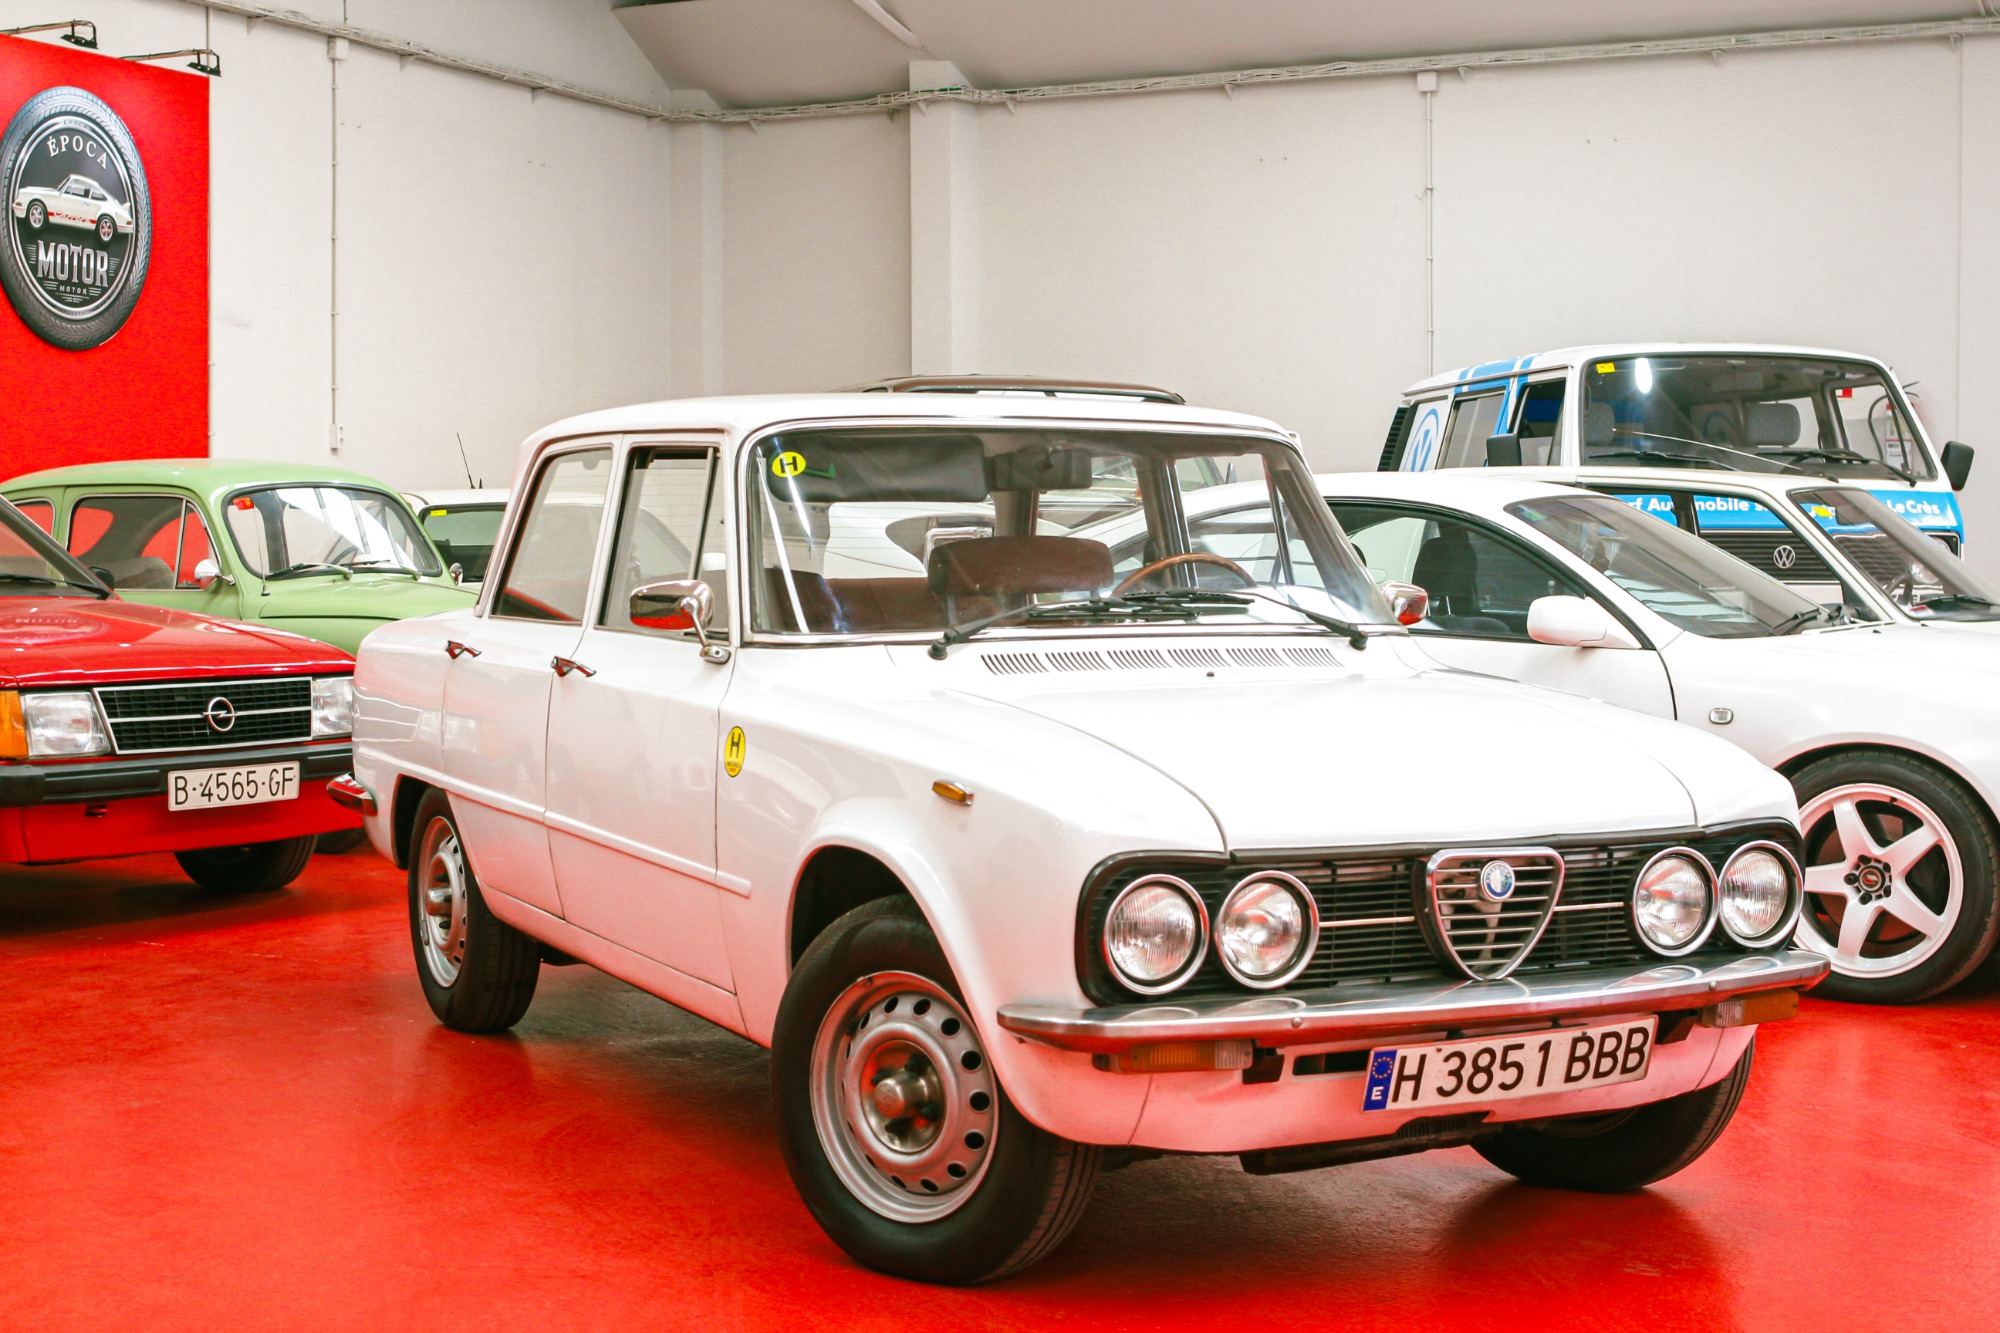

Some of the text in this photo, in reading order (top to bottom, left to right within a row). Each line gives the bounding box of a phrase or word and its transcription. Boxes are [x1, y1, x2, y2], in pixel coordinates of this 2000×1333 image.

[46, 135, 108, 170] ÉPOCA
[37, 239, 109, 288] MOTOR
[59, 285, 87, 295] MOTOR
[779, 456, 799, 474] H
[729, 731, 742, 759] H
[1391, 1025, 1650, 1103] H 3851 BBB
[1371, 1086, 1384, 1101] E
